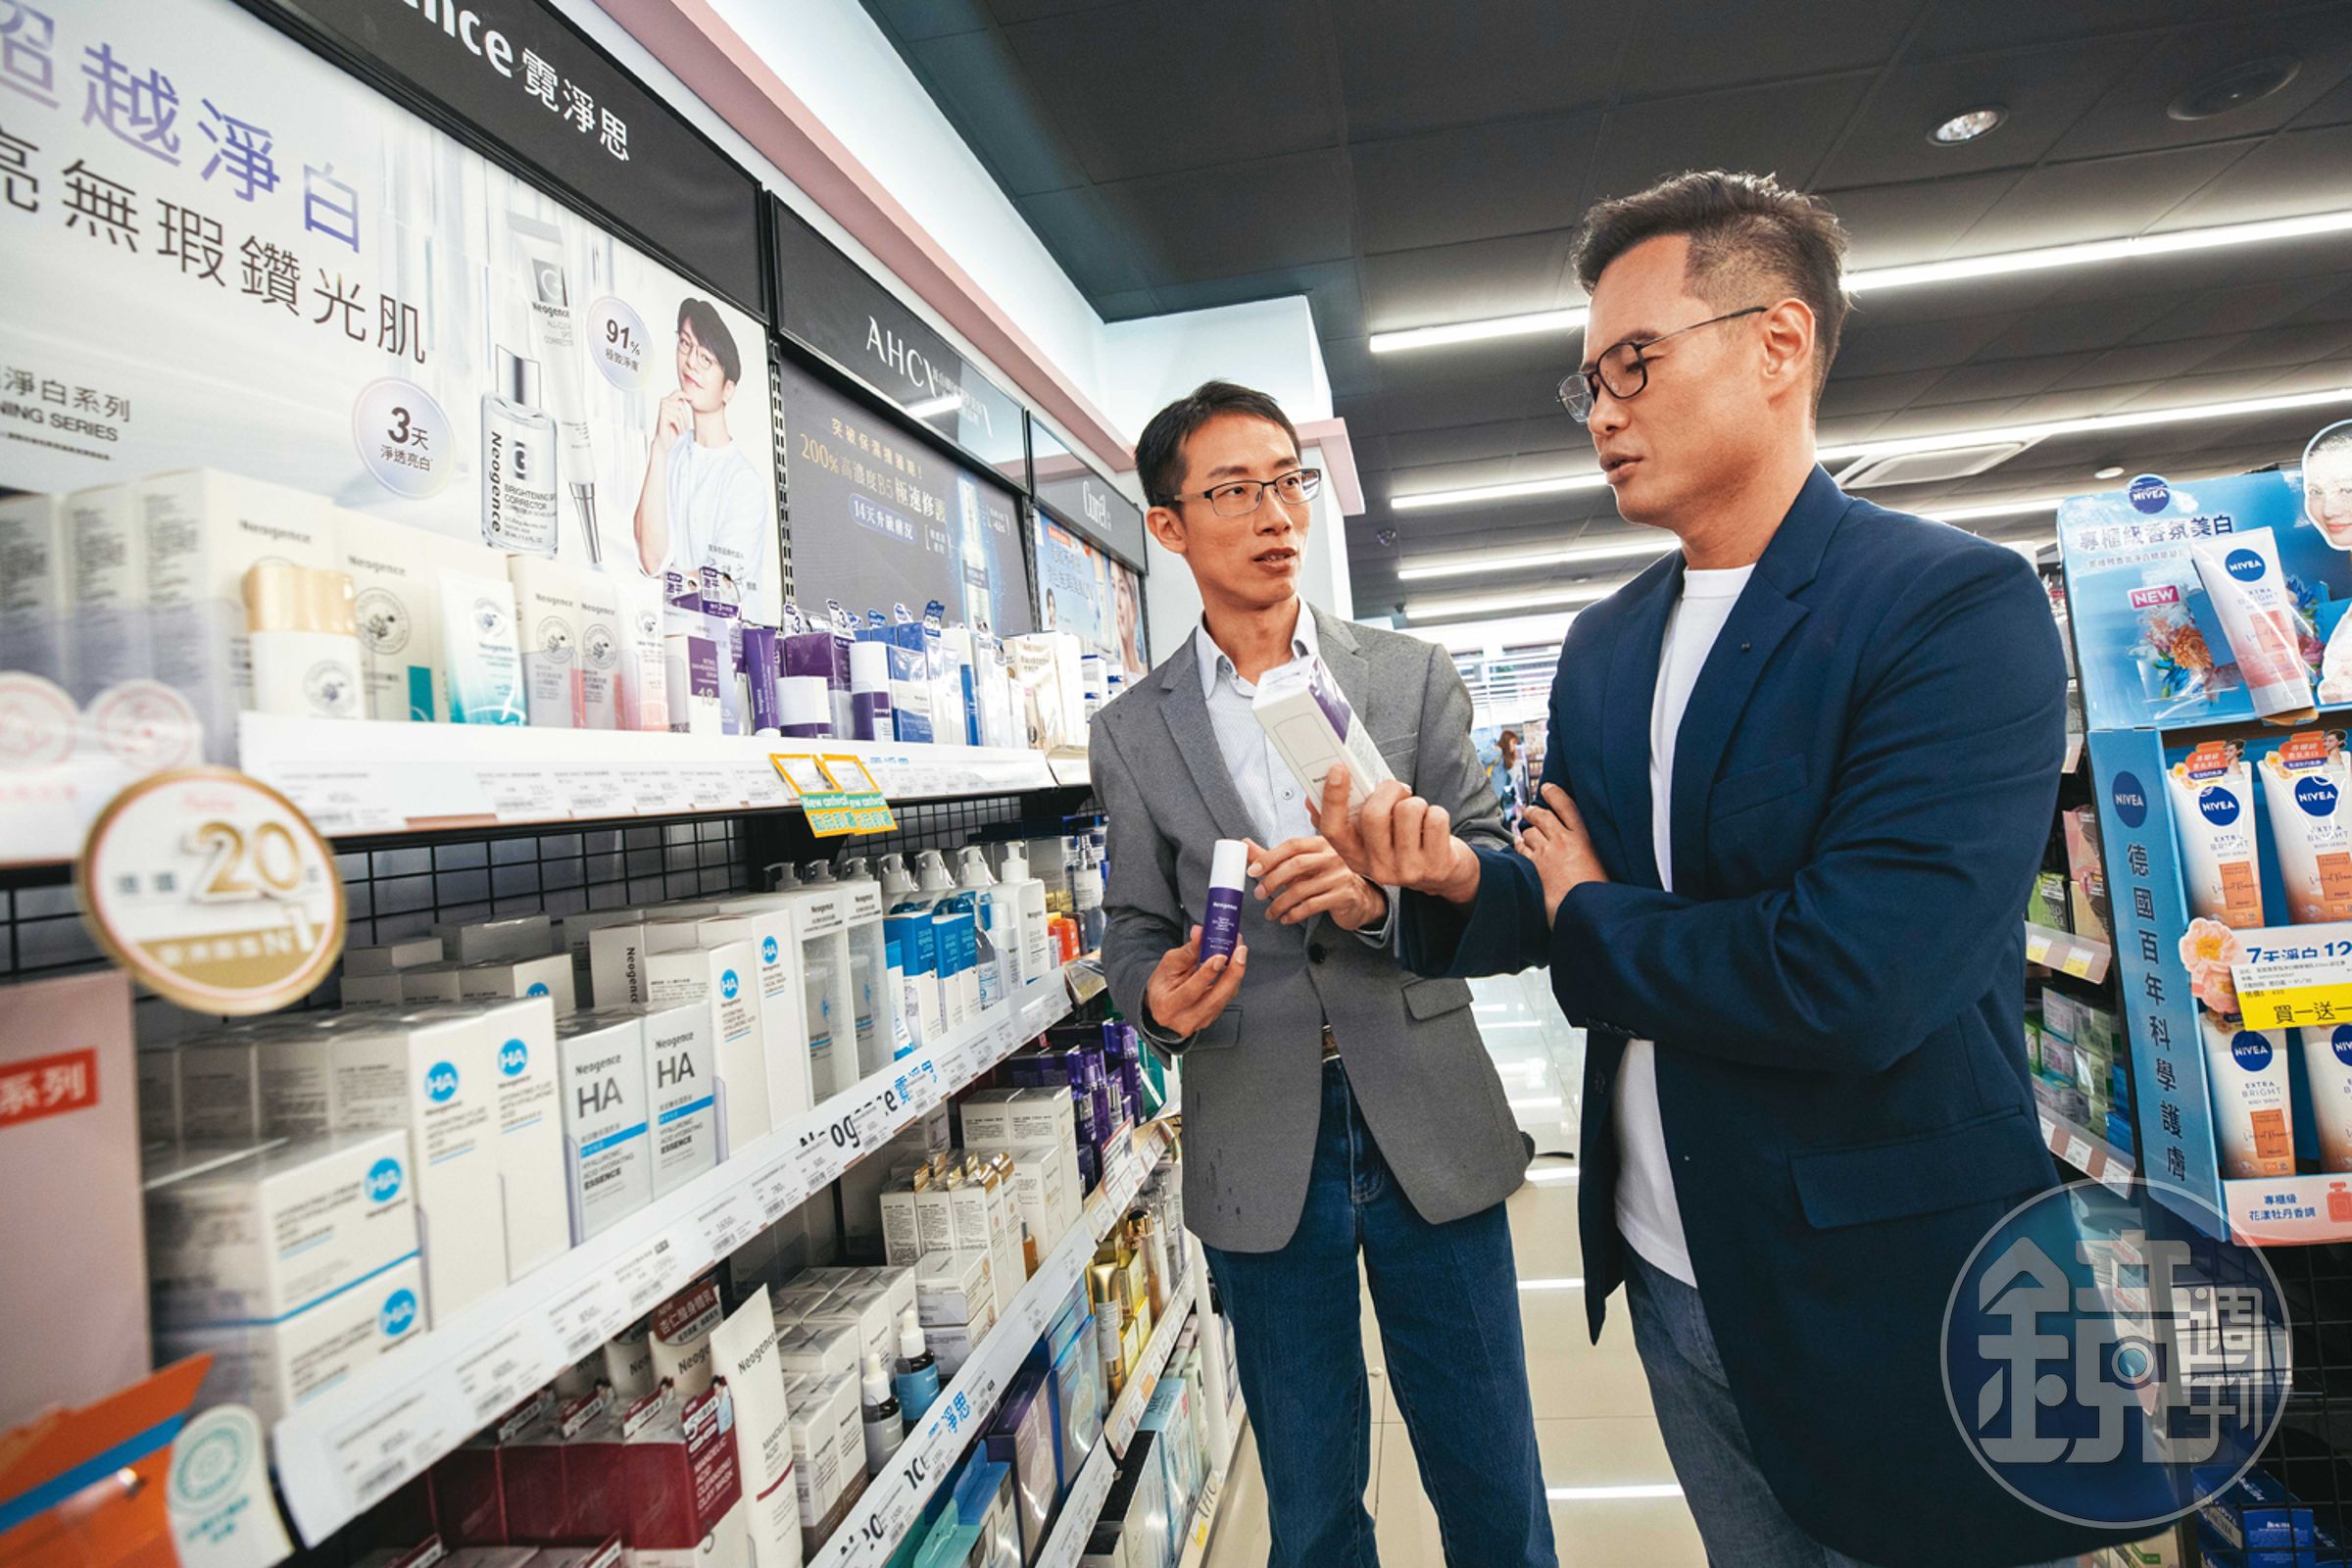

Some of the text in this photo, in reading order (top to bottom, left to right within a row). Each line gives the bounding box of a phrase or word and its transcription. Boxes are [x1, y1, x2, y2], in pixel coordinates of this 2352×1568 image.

[403, 0, 630, 161] nce 霓淨思
[606, 319, 641, 356] 91%
[3, 367, 130, 422] 淨白系列
[50, 413, 119, 442] SERIES
[380, 444, 431, 471] 淨透亮白
[489, 431, 502, 532] Neogence
[2132, 492, 2167, 501] NIVEA
[2229, 560, 2263, 572] NIVEA
[2134, 589, 2175, 606] NEW
[2115, 793, 2144, 808] NIVEA
[2202, 800, 2236, 812] NIVEA
[2298, 790, 2335, 803] NIVEA
[762, 945, 778, 957] HA
[625, 947, 637, 1004] Neogence
[721, 976, 738, 991] HA
[2127, 844, 2185, 1182] 德國百年科學護膚
[2274, 1002, 2352, 1025] 買一送一
[655, 1031, 694, 1051] Neogence
[2234, 1045, 2269, 1056] NIVEA
[500, 1049, 527, 1068] HA
[574, 1054, 622, 1077] Neogence
[658, 1052, 696, 1089] HA
[0, 1061, 87, 1116] 系列
[425, 1073, 457, 1096] HA
[2241, 1086, 2281, 1099] BRIGHT
[577, 1077, 623, 1120] HA
[661, 1135, 693, 1155] ESSENCE
[583, 1167, 622, 1192] ESSENCE
